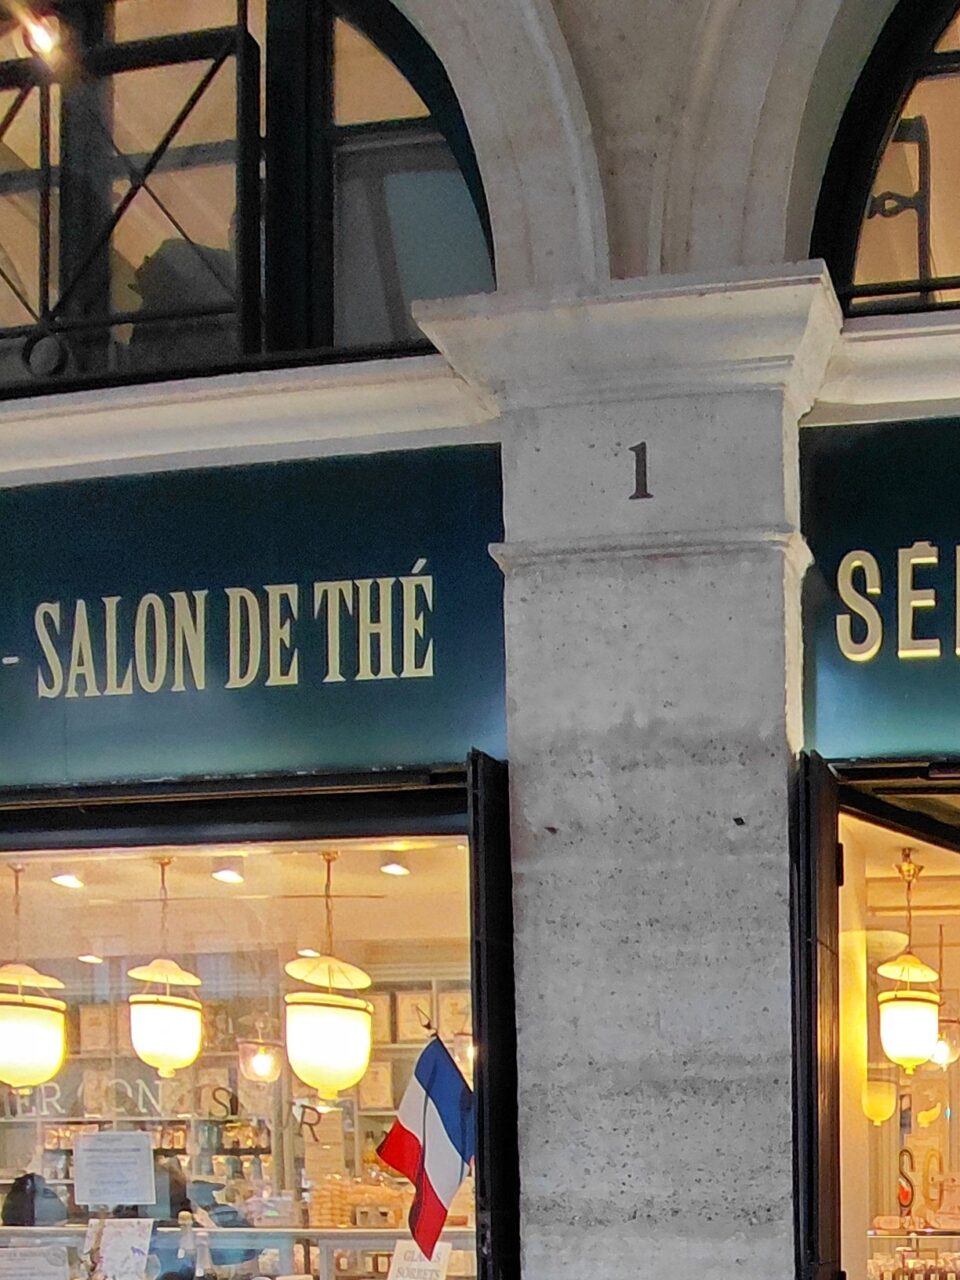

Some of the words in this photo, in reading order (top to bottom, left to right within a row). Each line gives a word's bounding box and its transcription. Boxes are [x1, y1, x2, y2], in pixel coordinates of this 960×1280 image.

[628, 441, 654, 500] 1
[35, 589, 209, 699] SALON
[224, 583, 299, 690] DE
[313, 558, 434, 683] THÉ
